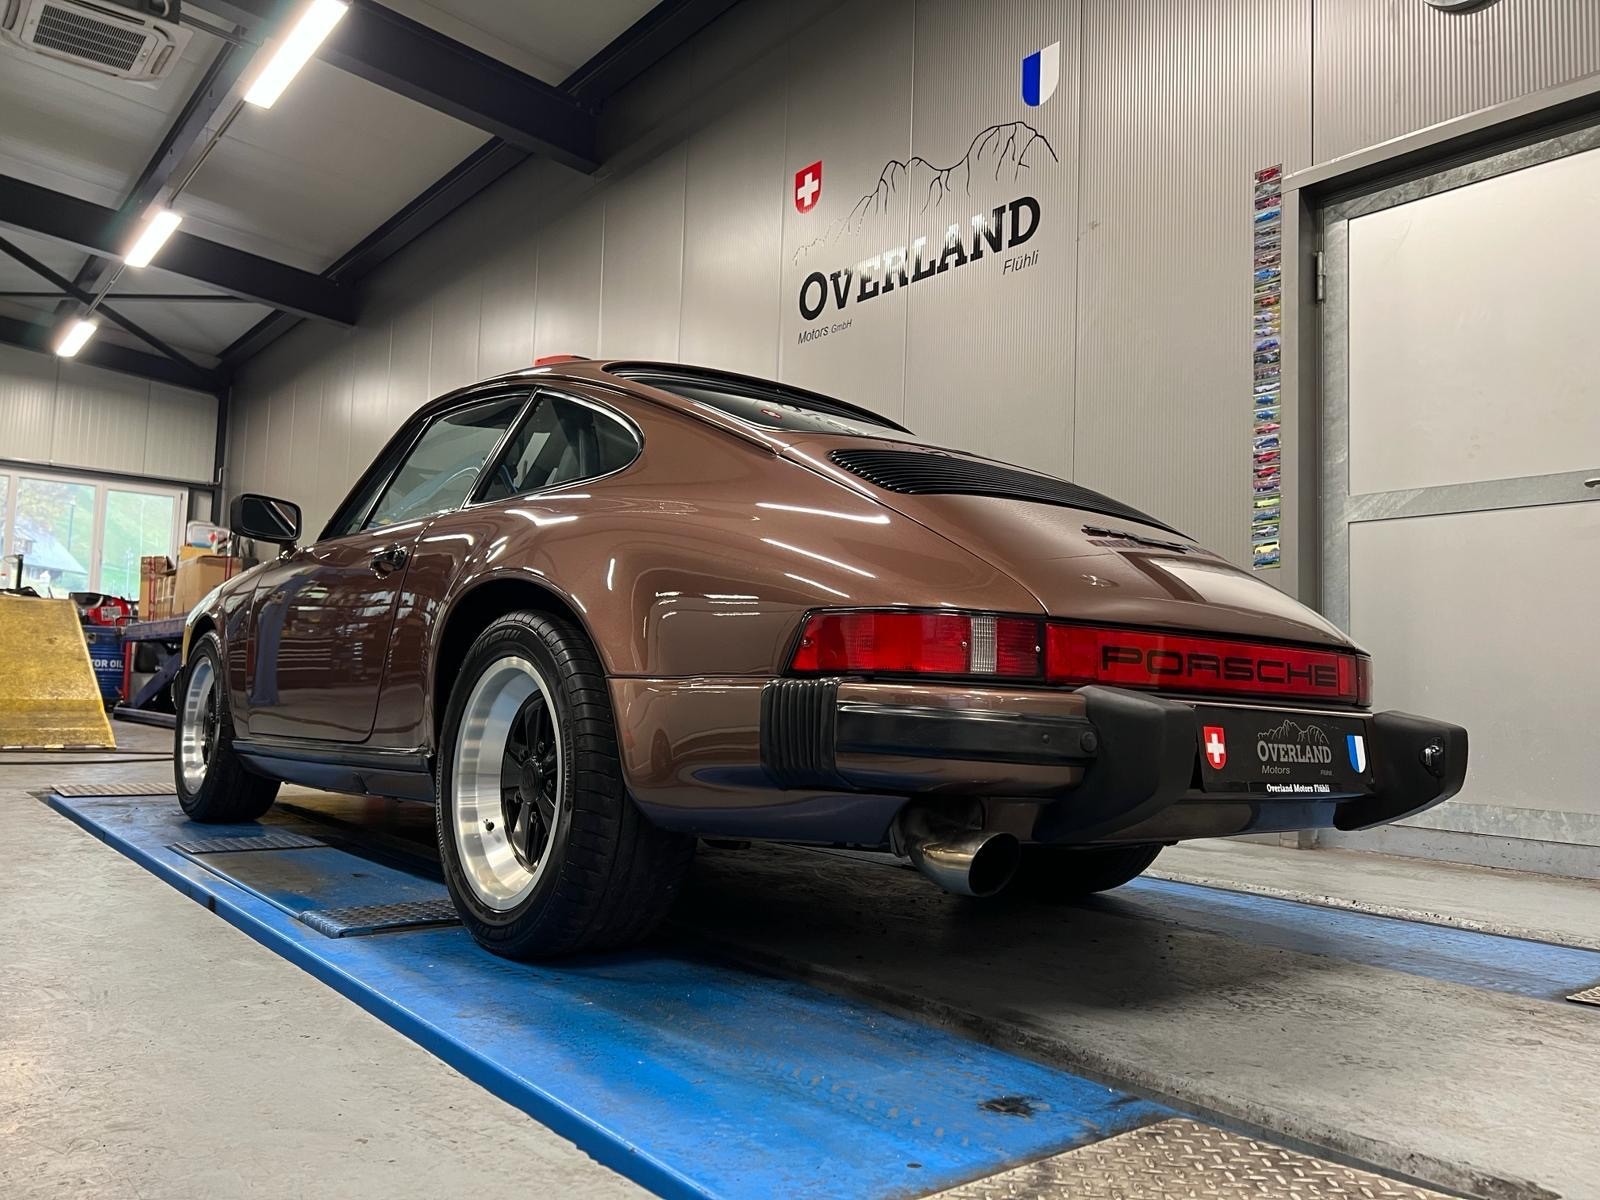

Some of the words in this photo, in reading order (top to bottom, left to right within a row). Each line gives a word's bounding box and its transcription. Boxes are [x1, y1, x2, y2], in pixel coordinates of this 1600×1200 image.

[799, 196, 1041, 320] OVERLAND
[1003, 249, 1039, 275] Flühli
[797, 326, 829, 344] Motors
[110, 659, 124, 668] OIL
[1101, 645, 1337, 687] PORSCHE
[1257, 740, 1332, 763] OVERLAND
[1261, 764, 1291, 775] Motors
[1266, 783, 1294, 793] Overland
[1293, 783, 1314, 793] Motors
